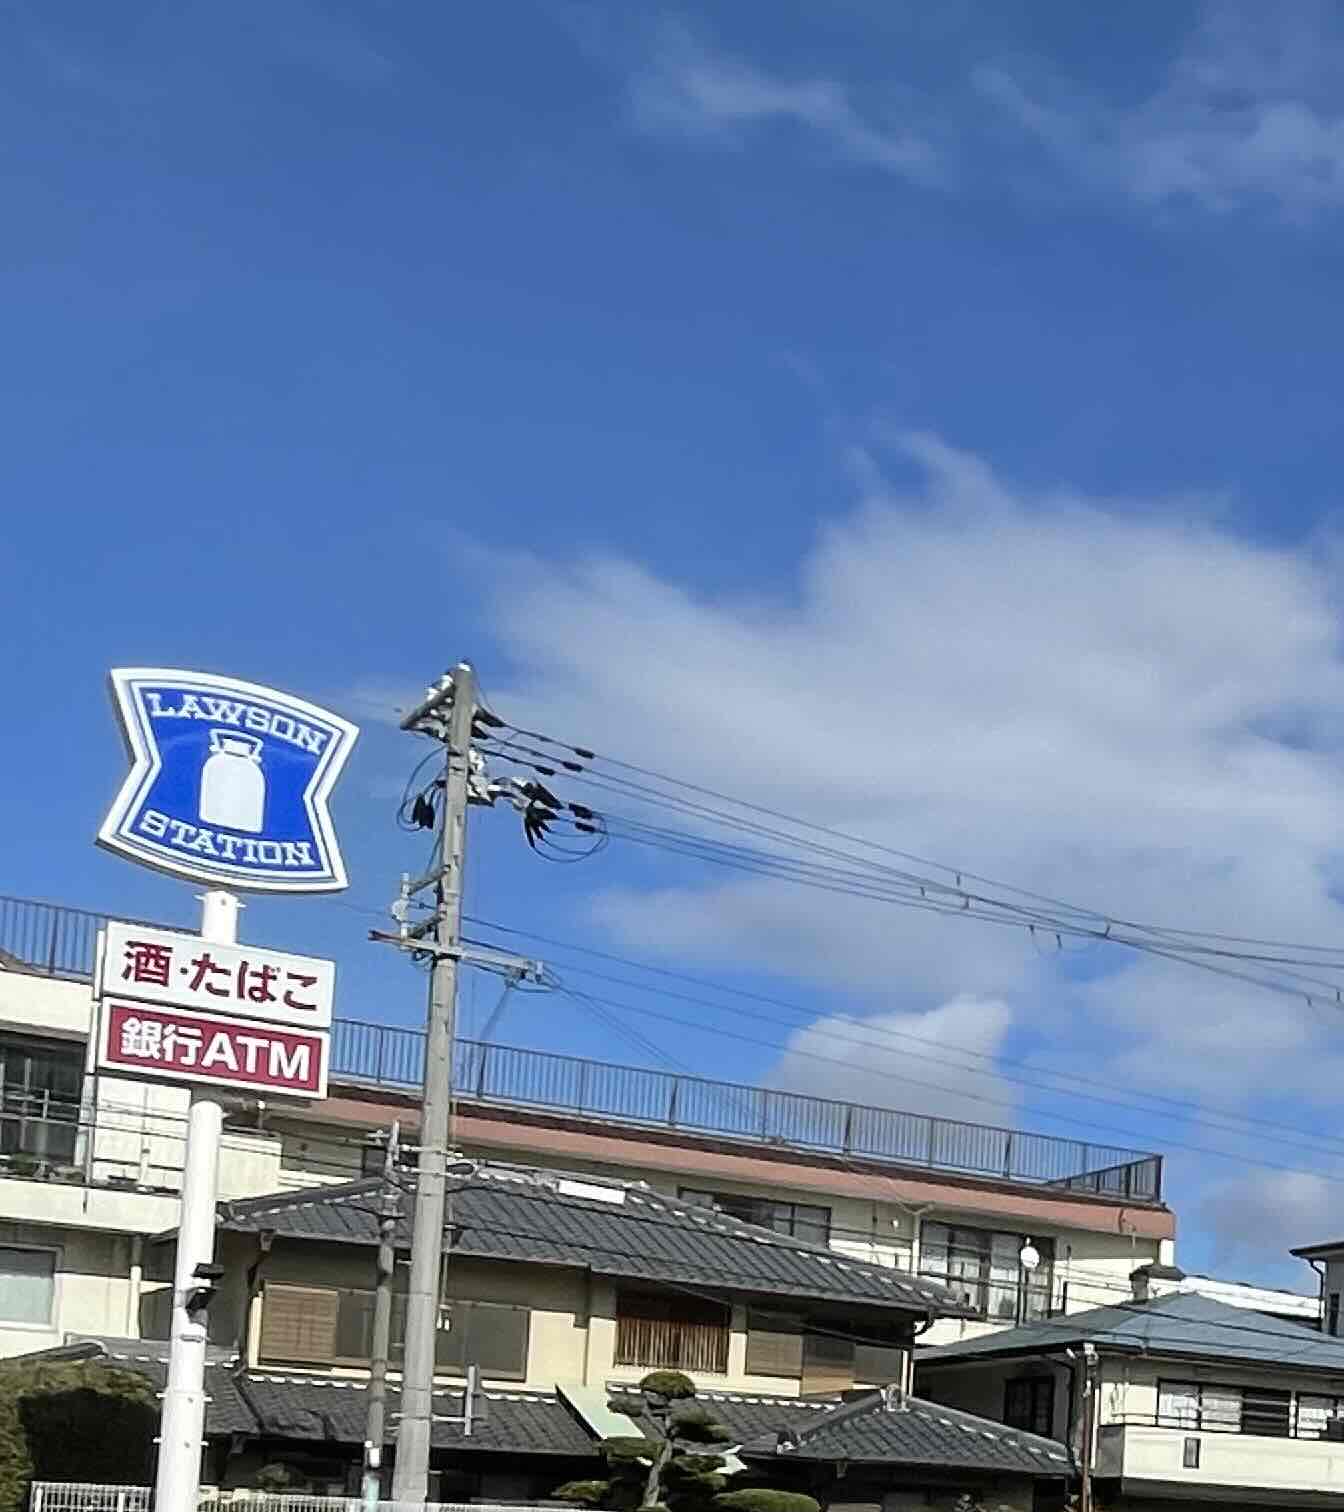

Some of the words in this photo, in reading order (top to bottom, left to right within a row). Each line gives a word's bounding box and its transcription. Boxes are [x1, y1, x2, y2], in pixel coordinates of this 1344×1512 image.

[146, 693, 328, 755] LAWSON
[139, 809, 315, 865] STATION
[120, 1016, 311, 1082] 銀行ATM
